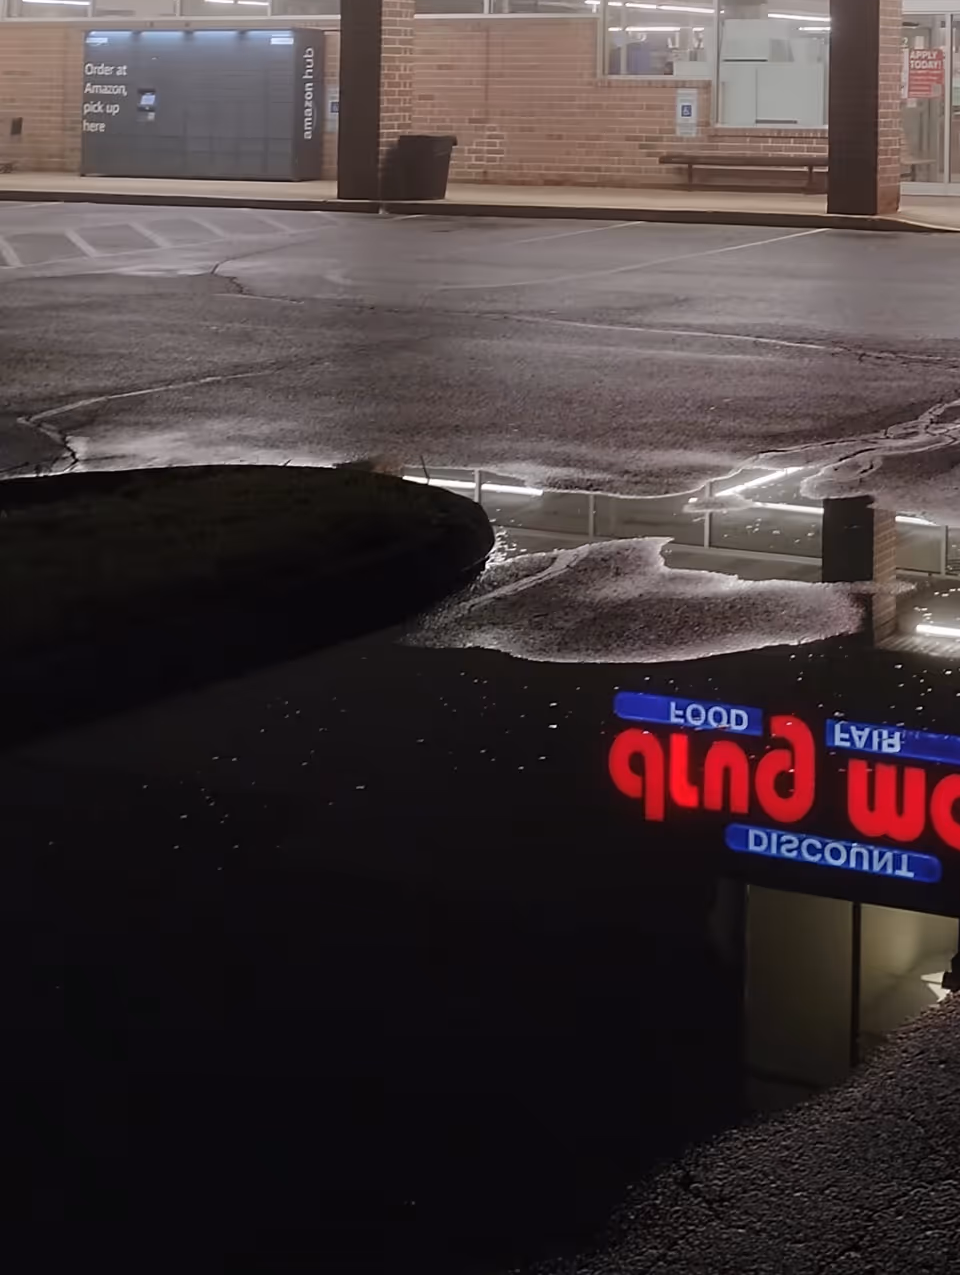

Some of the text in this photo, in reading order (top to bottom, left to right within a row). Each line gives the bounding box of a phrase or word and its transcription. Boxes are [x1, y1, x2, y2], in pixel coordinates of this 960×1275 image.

[910, 50, 938, 60] APPLY
[85, 63, 127, 76] Order at
[910, 60, 942, 70] TODAY!
[84, 83, 127, 96] Amazon,
[302, 47, 314, 140] amazon hub
[83, 101, 120, 116] pick up
[83, 119, 106, 132] here
